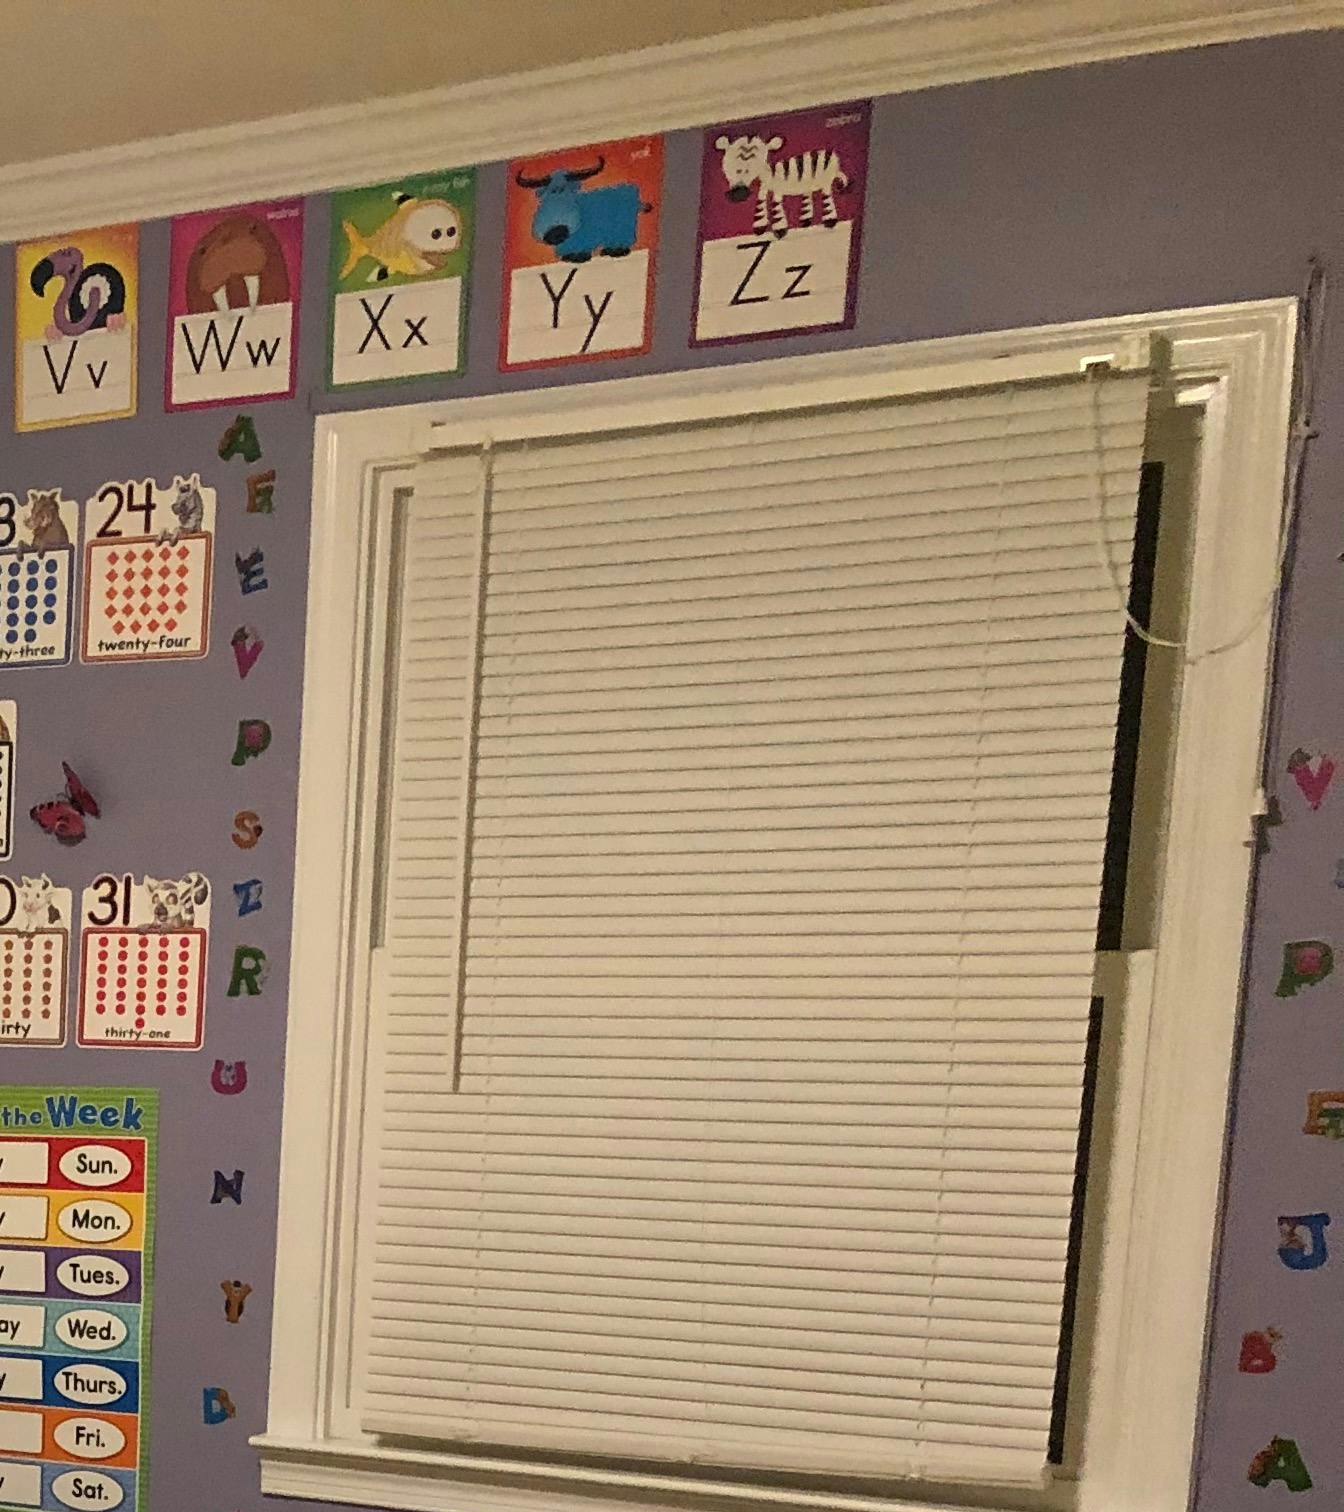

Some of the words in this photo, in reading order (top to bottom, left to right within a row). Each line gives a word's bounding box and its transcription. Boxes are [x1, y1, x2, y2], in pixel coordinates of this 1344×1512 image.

[729, 241, 813, 307] Zz
[540, 268, 613, 353] Yy
[358, 294, 429, 354] Xx
[181, 315, 281, 374] Ww
[43, 340, 108, 395] Vv
[96, 483, 156, 537] 24
[98, 635, 191, 654] twenty-four
[87, 876, 130, 926] 31
[105, 1026, 170, 1039] thirty-one
[1, 1106, 42, 1126] the
[46, 1094, 143, 1131] Week
[76, 1153, 118, 1174] Sun.
[71, 1209, 121, 1230] Mon.
[69, 1263, 120, 1285] Tues.
[67, 1318, 116, 1341] Wed.
[62, 1372, 122, 1395] Thurs.
[75, 1426, 106, 1448] Fri.
[71, 1479, 109, 1500] Sat.
